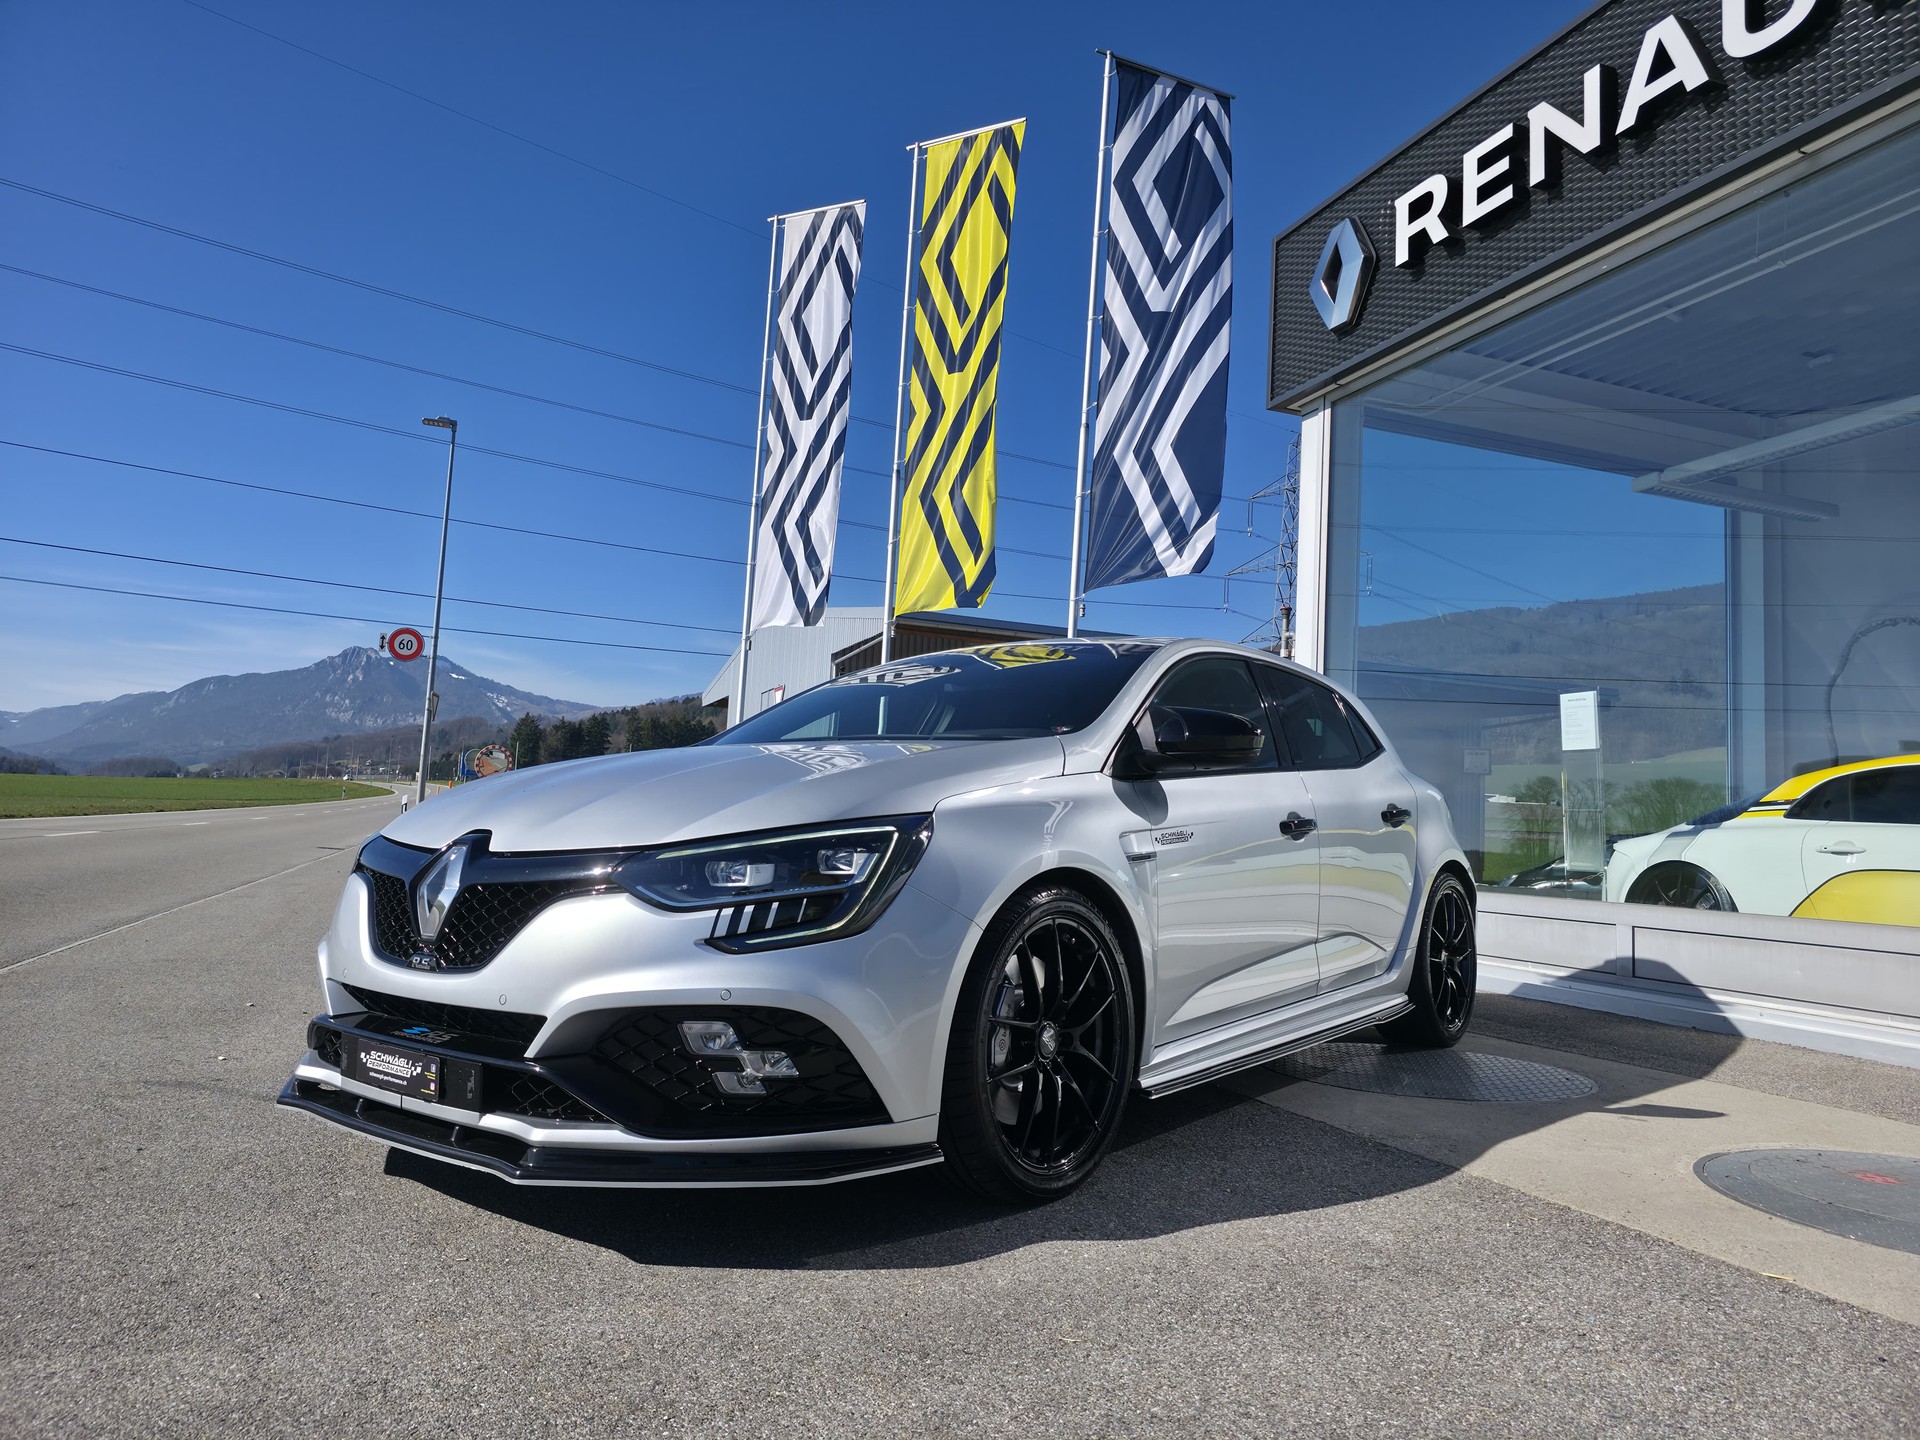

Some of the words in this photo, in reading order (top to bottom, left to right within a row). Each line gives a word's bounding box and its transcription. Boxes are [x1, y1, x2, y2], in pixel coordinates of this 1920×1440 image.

[398, 638, 413, 651] 60
[368, 1059, 411, 1077] PERFORMANCE
[370, 1050, 413, 1069] SCHWÄGLI
